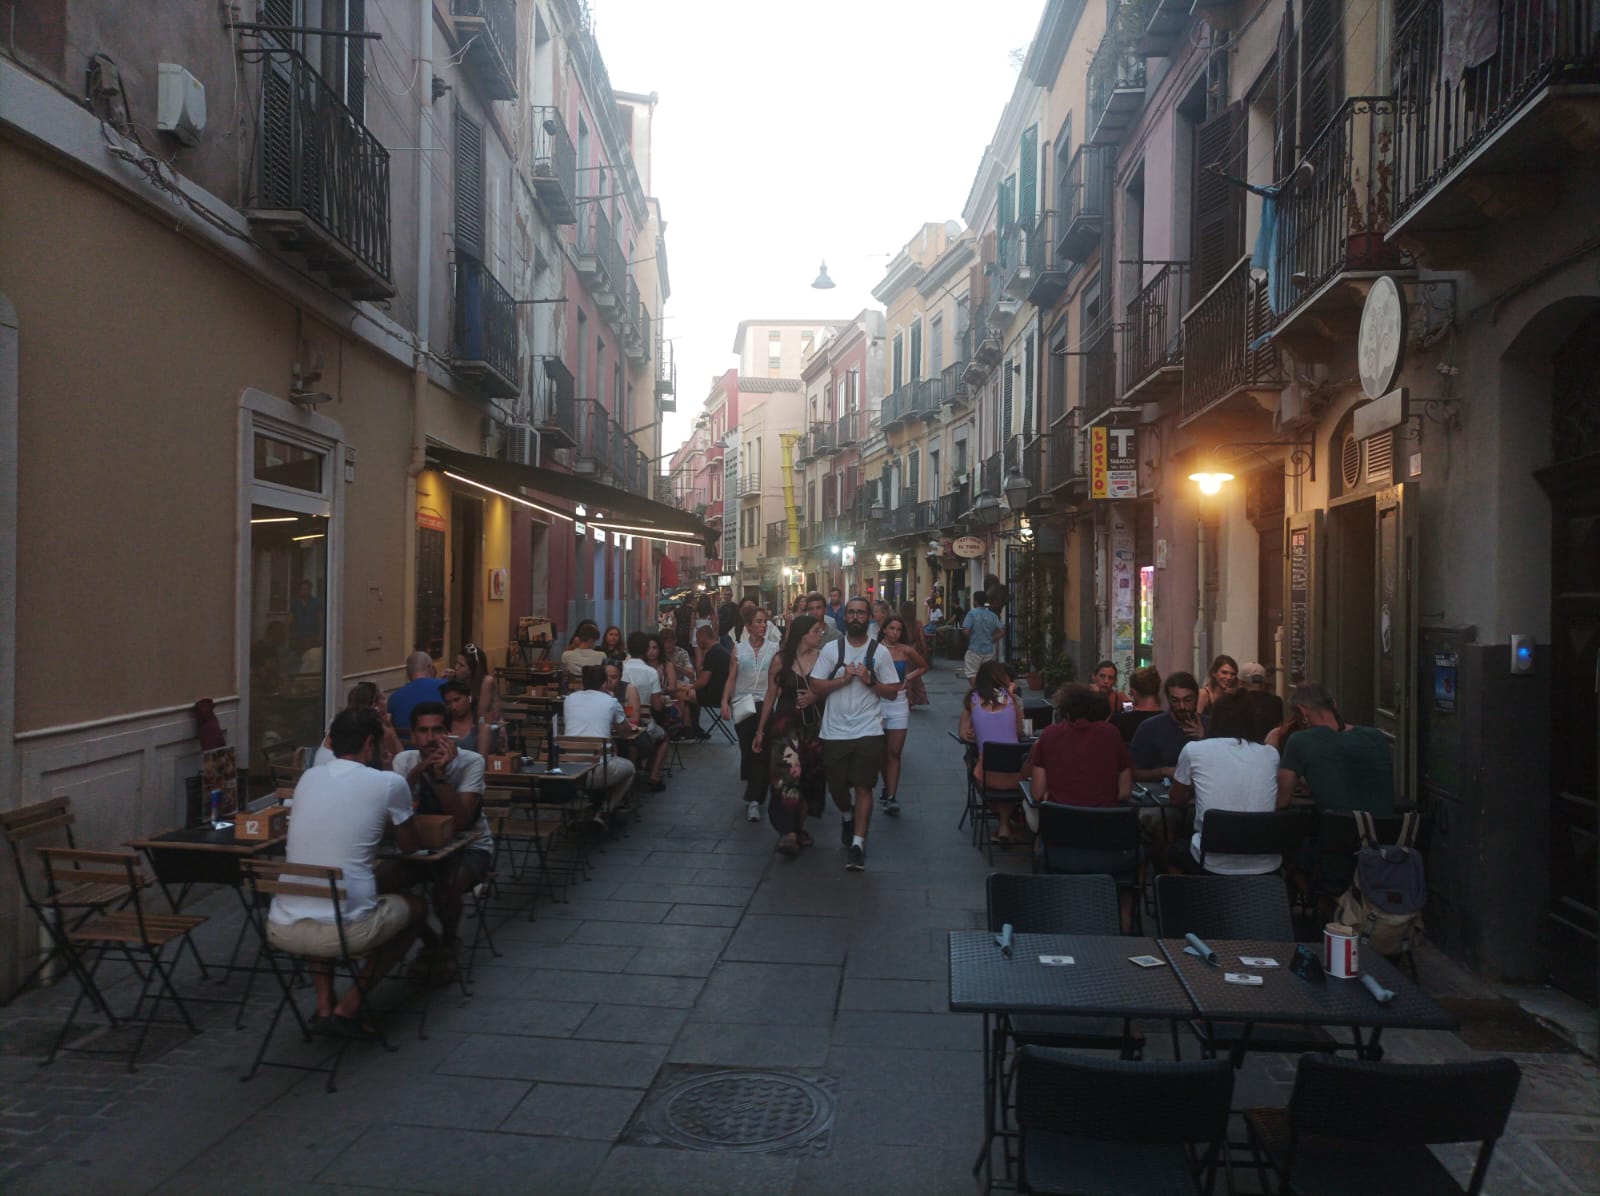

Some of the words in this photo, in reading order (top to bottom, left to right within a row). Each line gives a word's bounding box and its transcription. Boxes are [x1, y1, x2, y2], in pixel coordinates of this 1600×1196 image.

[1110, 428, 1135, 457] T
[1094, 431, 1104, 490] LOTTO
[245, 820, 259, 835] 12
